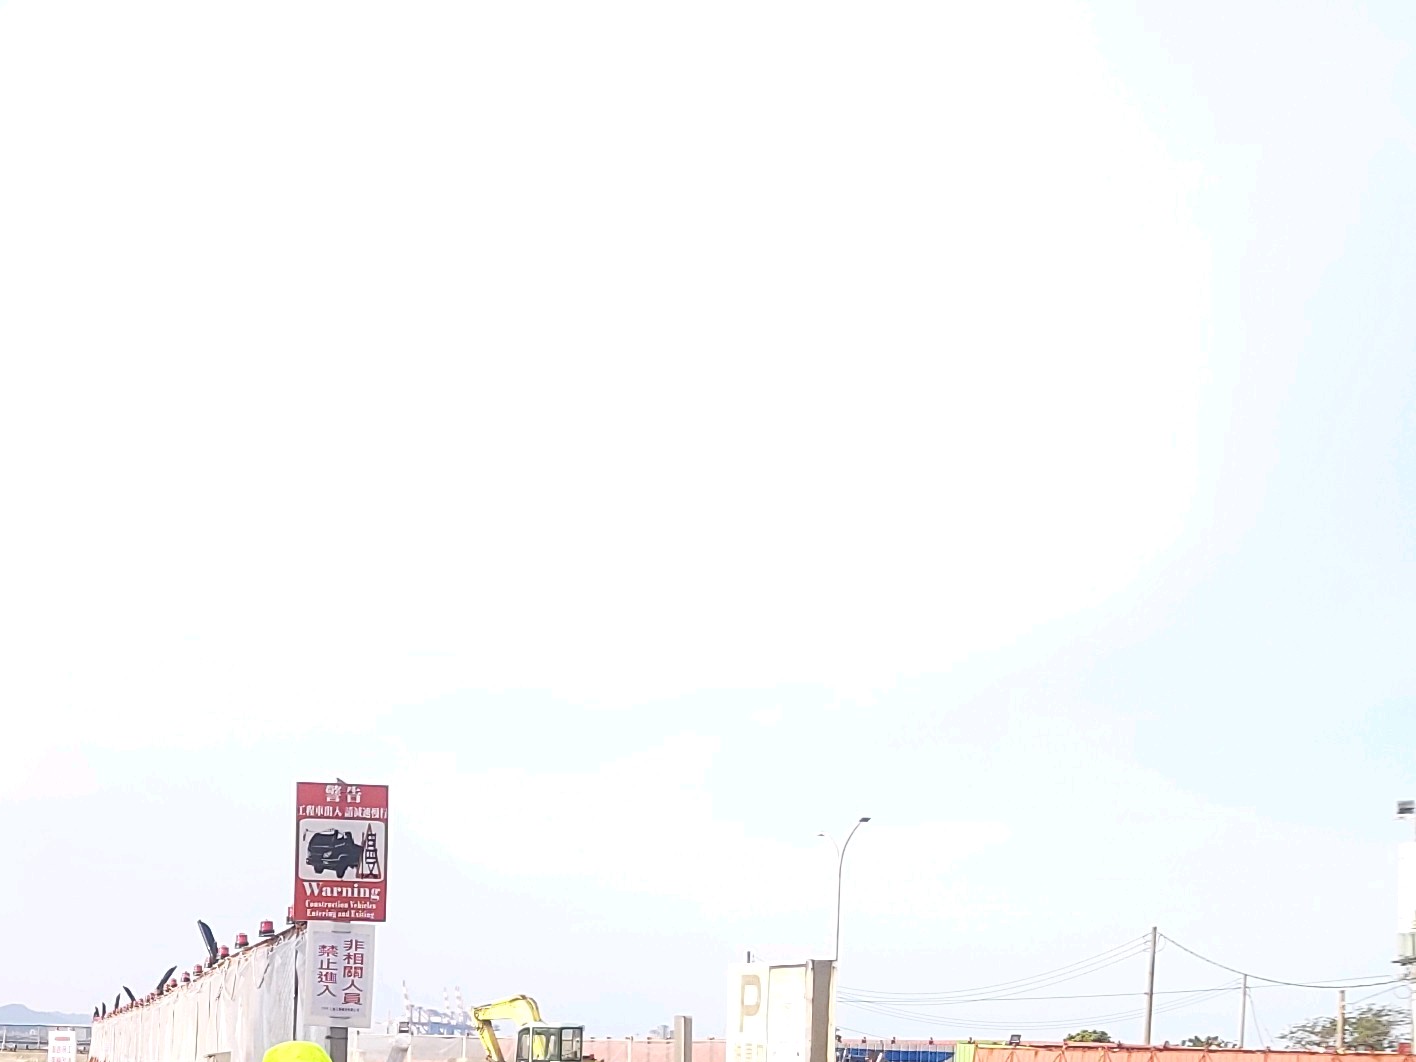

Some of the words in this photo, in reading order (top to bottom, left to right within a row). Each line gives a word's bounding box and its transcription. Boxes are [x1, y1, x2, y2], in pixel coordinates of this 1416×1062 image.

[325, 785, 361, 803] 警告
[302, 882, 381, 901] Warning
[305, 900, 349, 909] Construction
[350, 900, 377, 910] Vehicles
[306, 909, 337, 918] Entering
[338, 910, 350, 918] and
[351, 910, 375, 919] Exiting
[316, 944, 338, 997] 禁止進入
[342, 939, 365, 1005] 非相關人員
